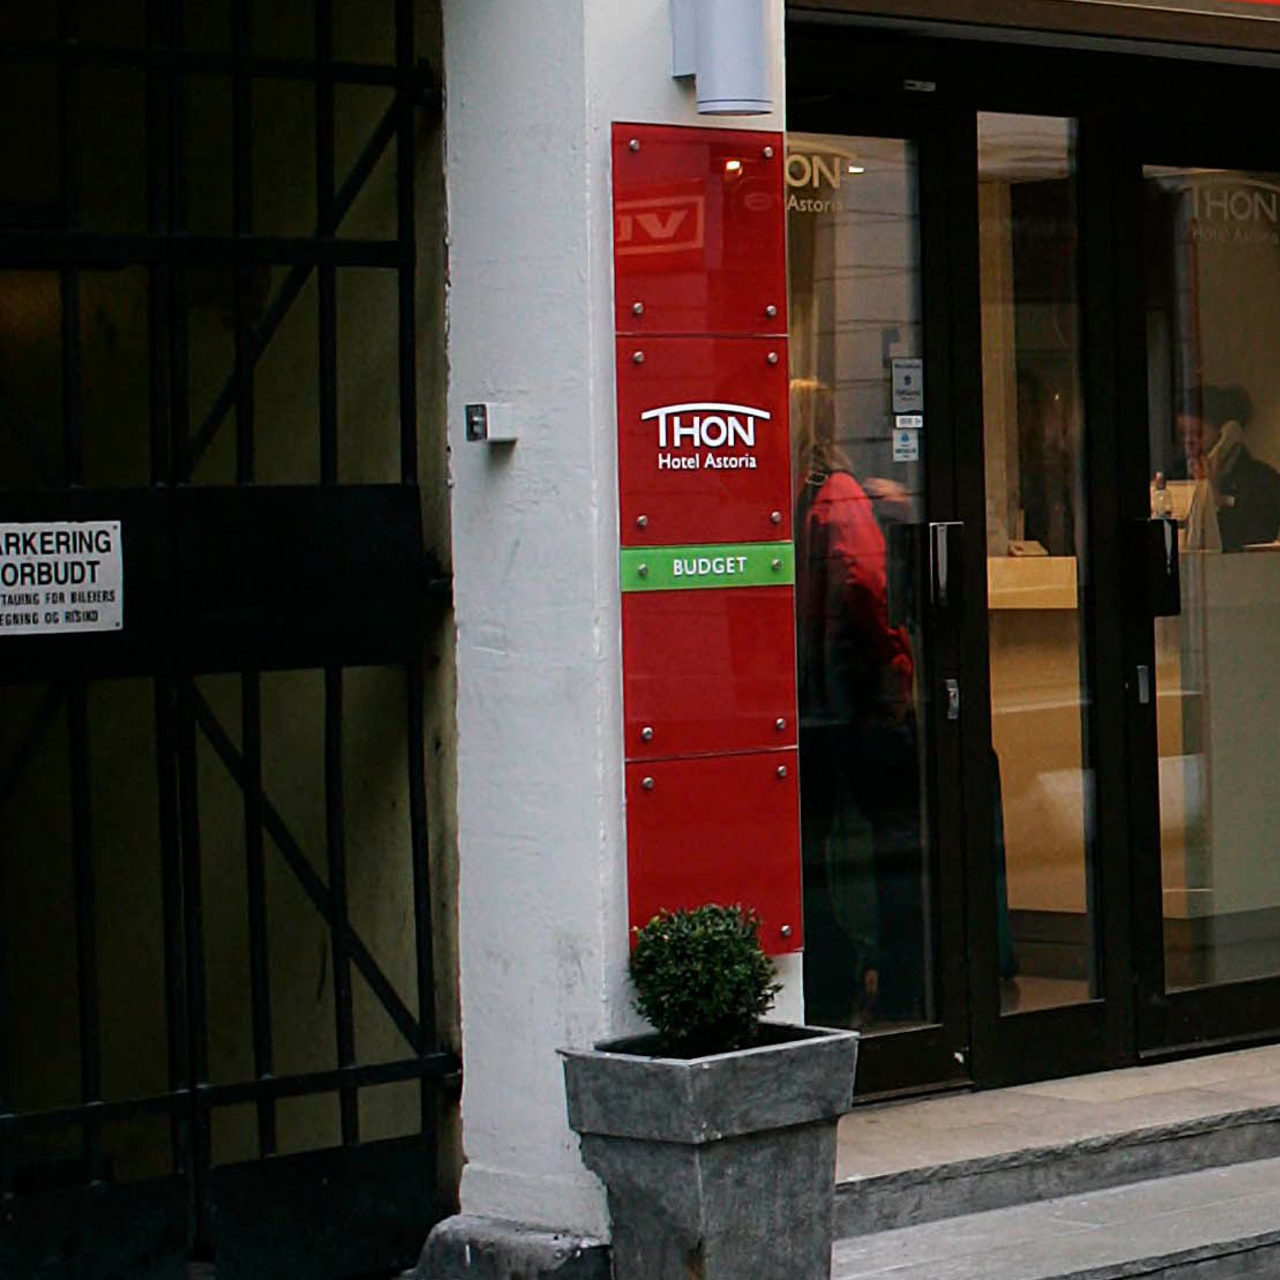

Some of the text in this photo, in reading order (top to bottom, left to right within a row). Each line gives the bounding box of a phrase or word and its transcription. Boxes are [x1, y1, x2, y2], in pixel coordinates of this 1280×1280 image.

[641, 402, 771, 448] THON
[658, 451, 757, 470] Hotel Astoria
[0, 530, 111, 556] RKERING
[0, 560, 101, 587] ORBUDT
[673, 556, 747, 577] BUDGET
[45, 592, 65, 605] FOR
[45, 611, 60, 624] OG
